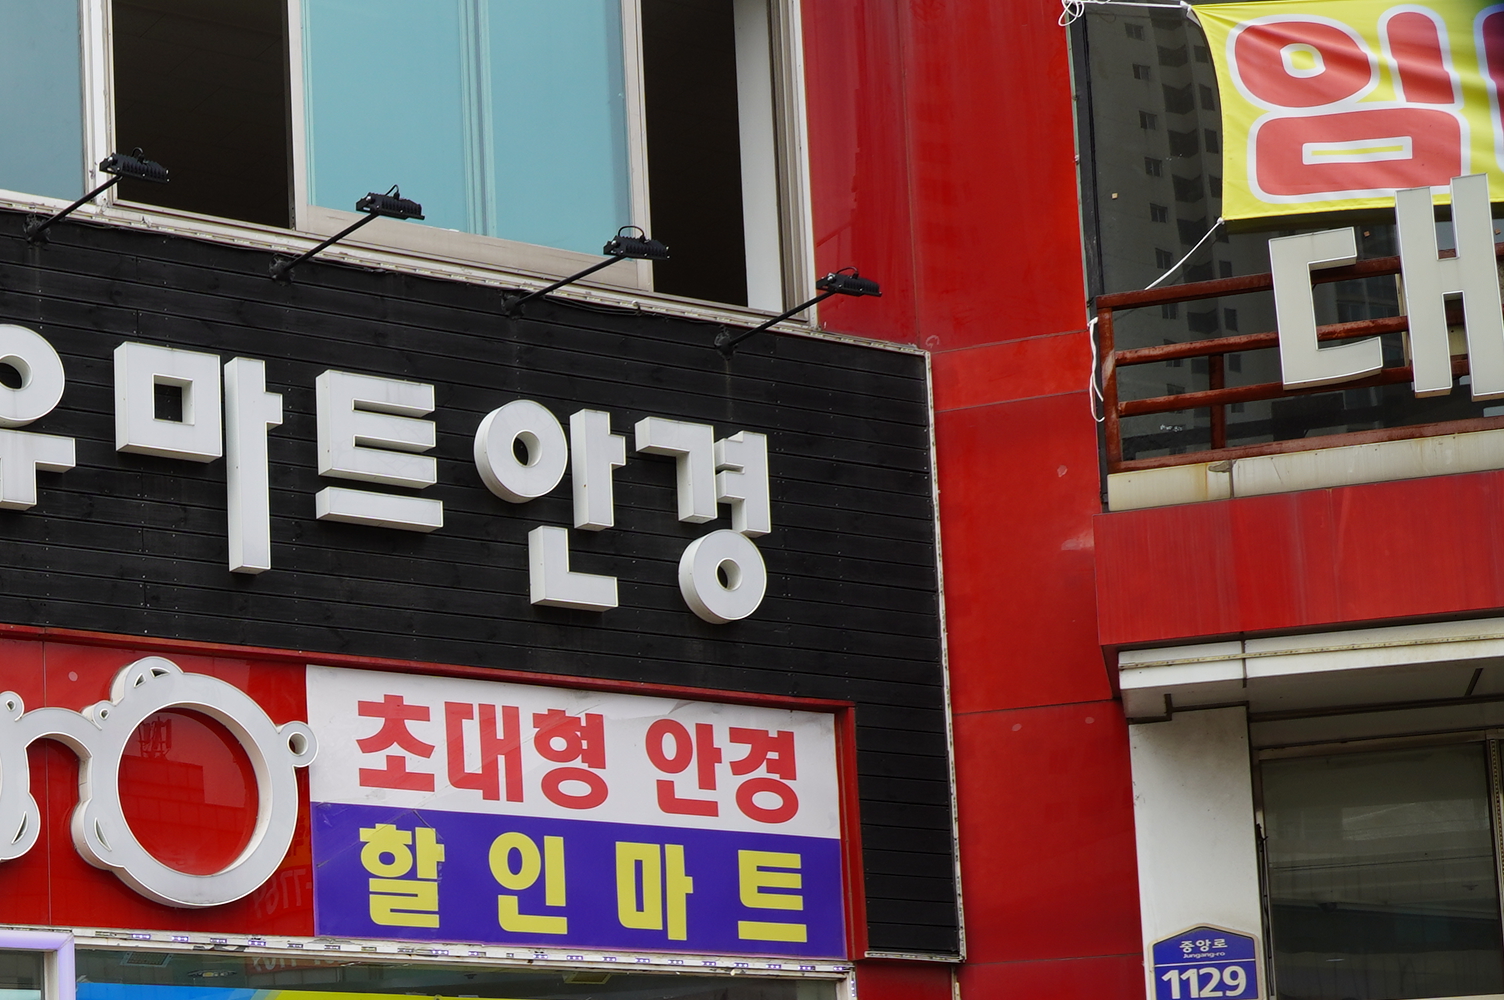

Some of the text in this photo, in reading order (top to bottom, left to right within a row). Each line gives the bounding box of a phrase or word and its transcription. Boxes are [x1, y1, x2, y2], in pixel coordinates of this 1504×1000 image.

[356, 694, 799, 824] 초대형 안경
[1179, 939, 1228, 952] 중앙로
[1183, 951, 1225, 959] Jungang-ro
[1161, 965, 1247, 999] 1129
